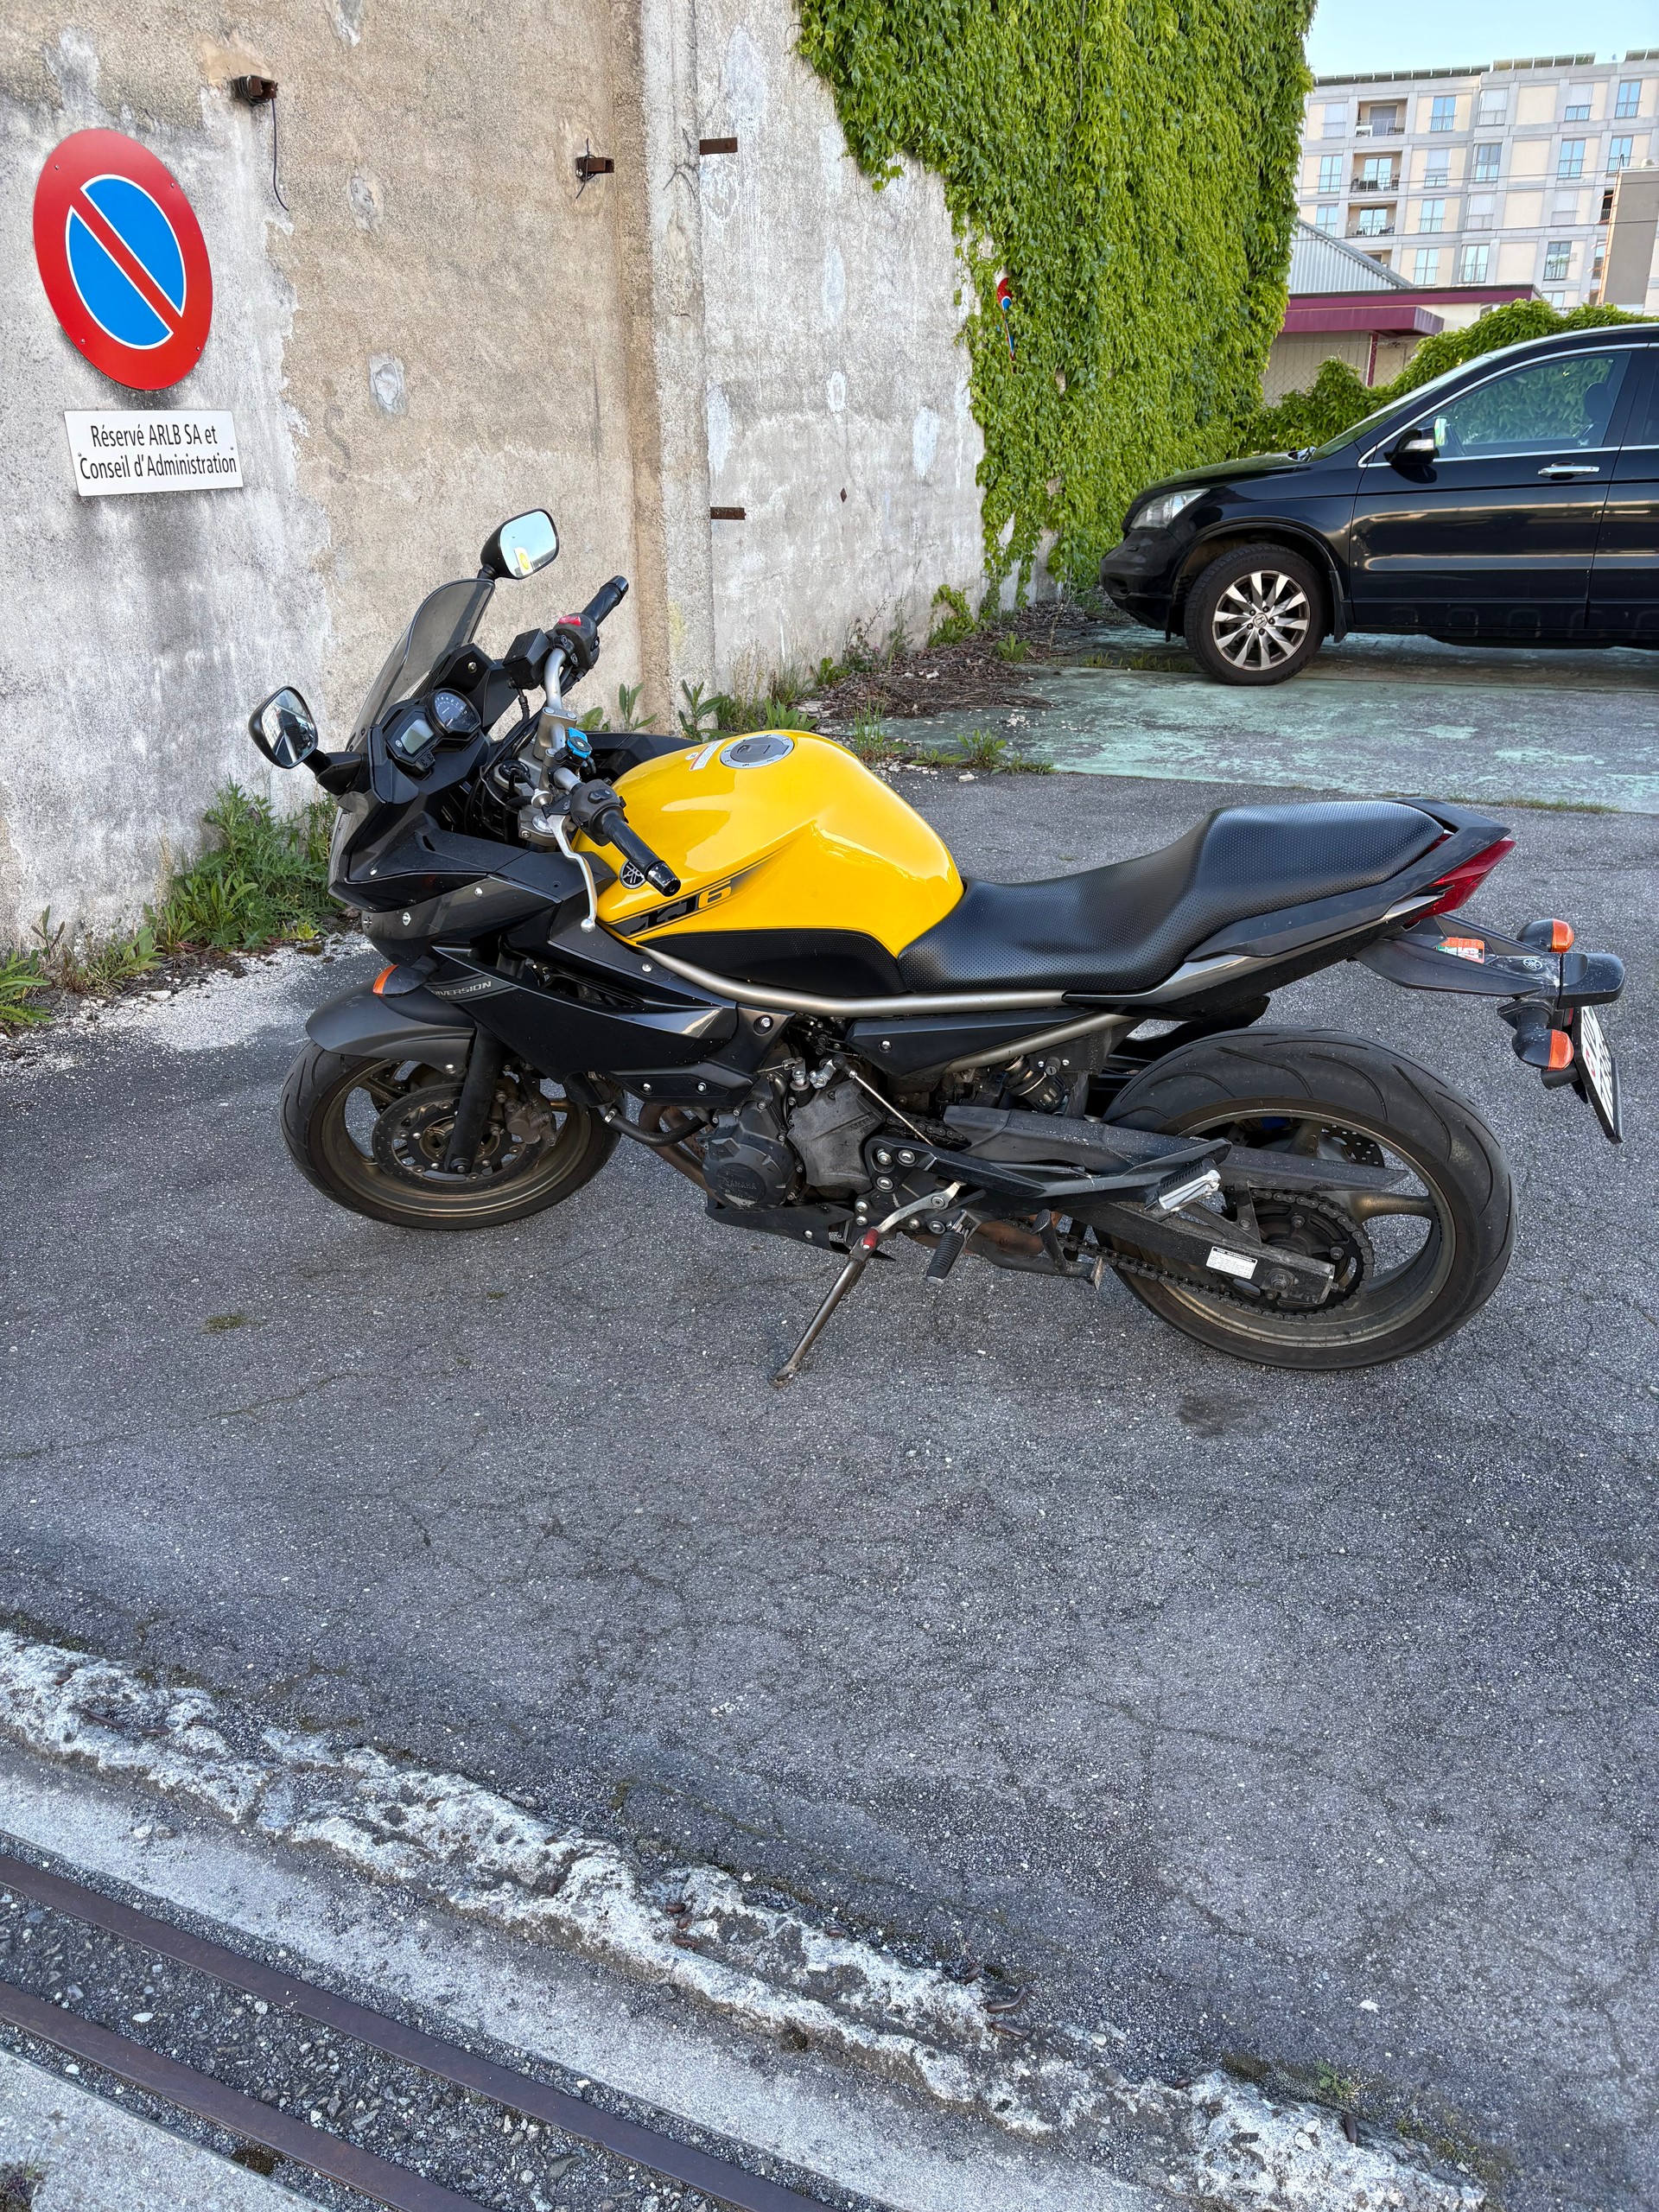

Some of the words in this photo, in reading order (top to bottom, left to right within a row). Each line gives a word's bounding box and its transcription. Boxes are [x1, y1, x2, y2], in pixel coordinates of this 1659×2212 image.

[90, 423, 145, 448] Réservé
[149, 423, 181, 446] ARLB
[184, 423, 202, 445] SA
[205, 424, 218, 444] et
[79, 454, 131, 479] Conseil
[134, 452, 237, 477] d'Administration
[630, 880, 732, 934] XJ6
